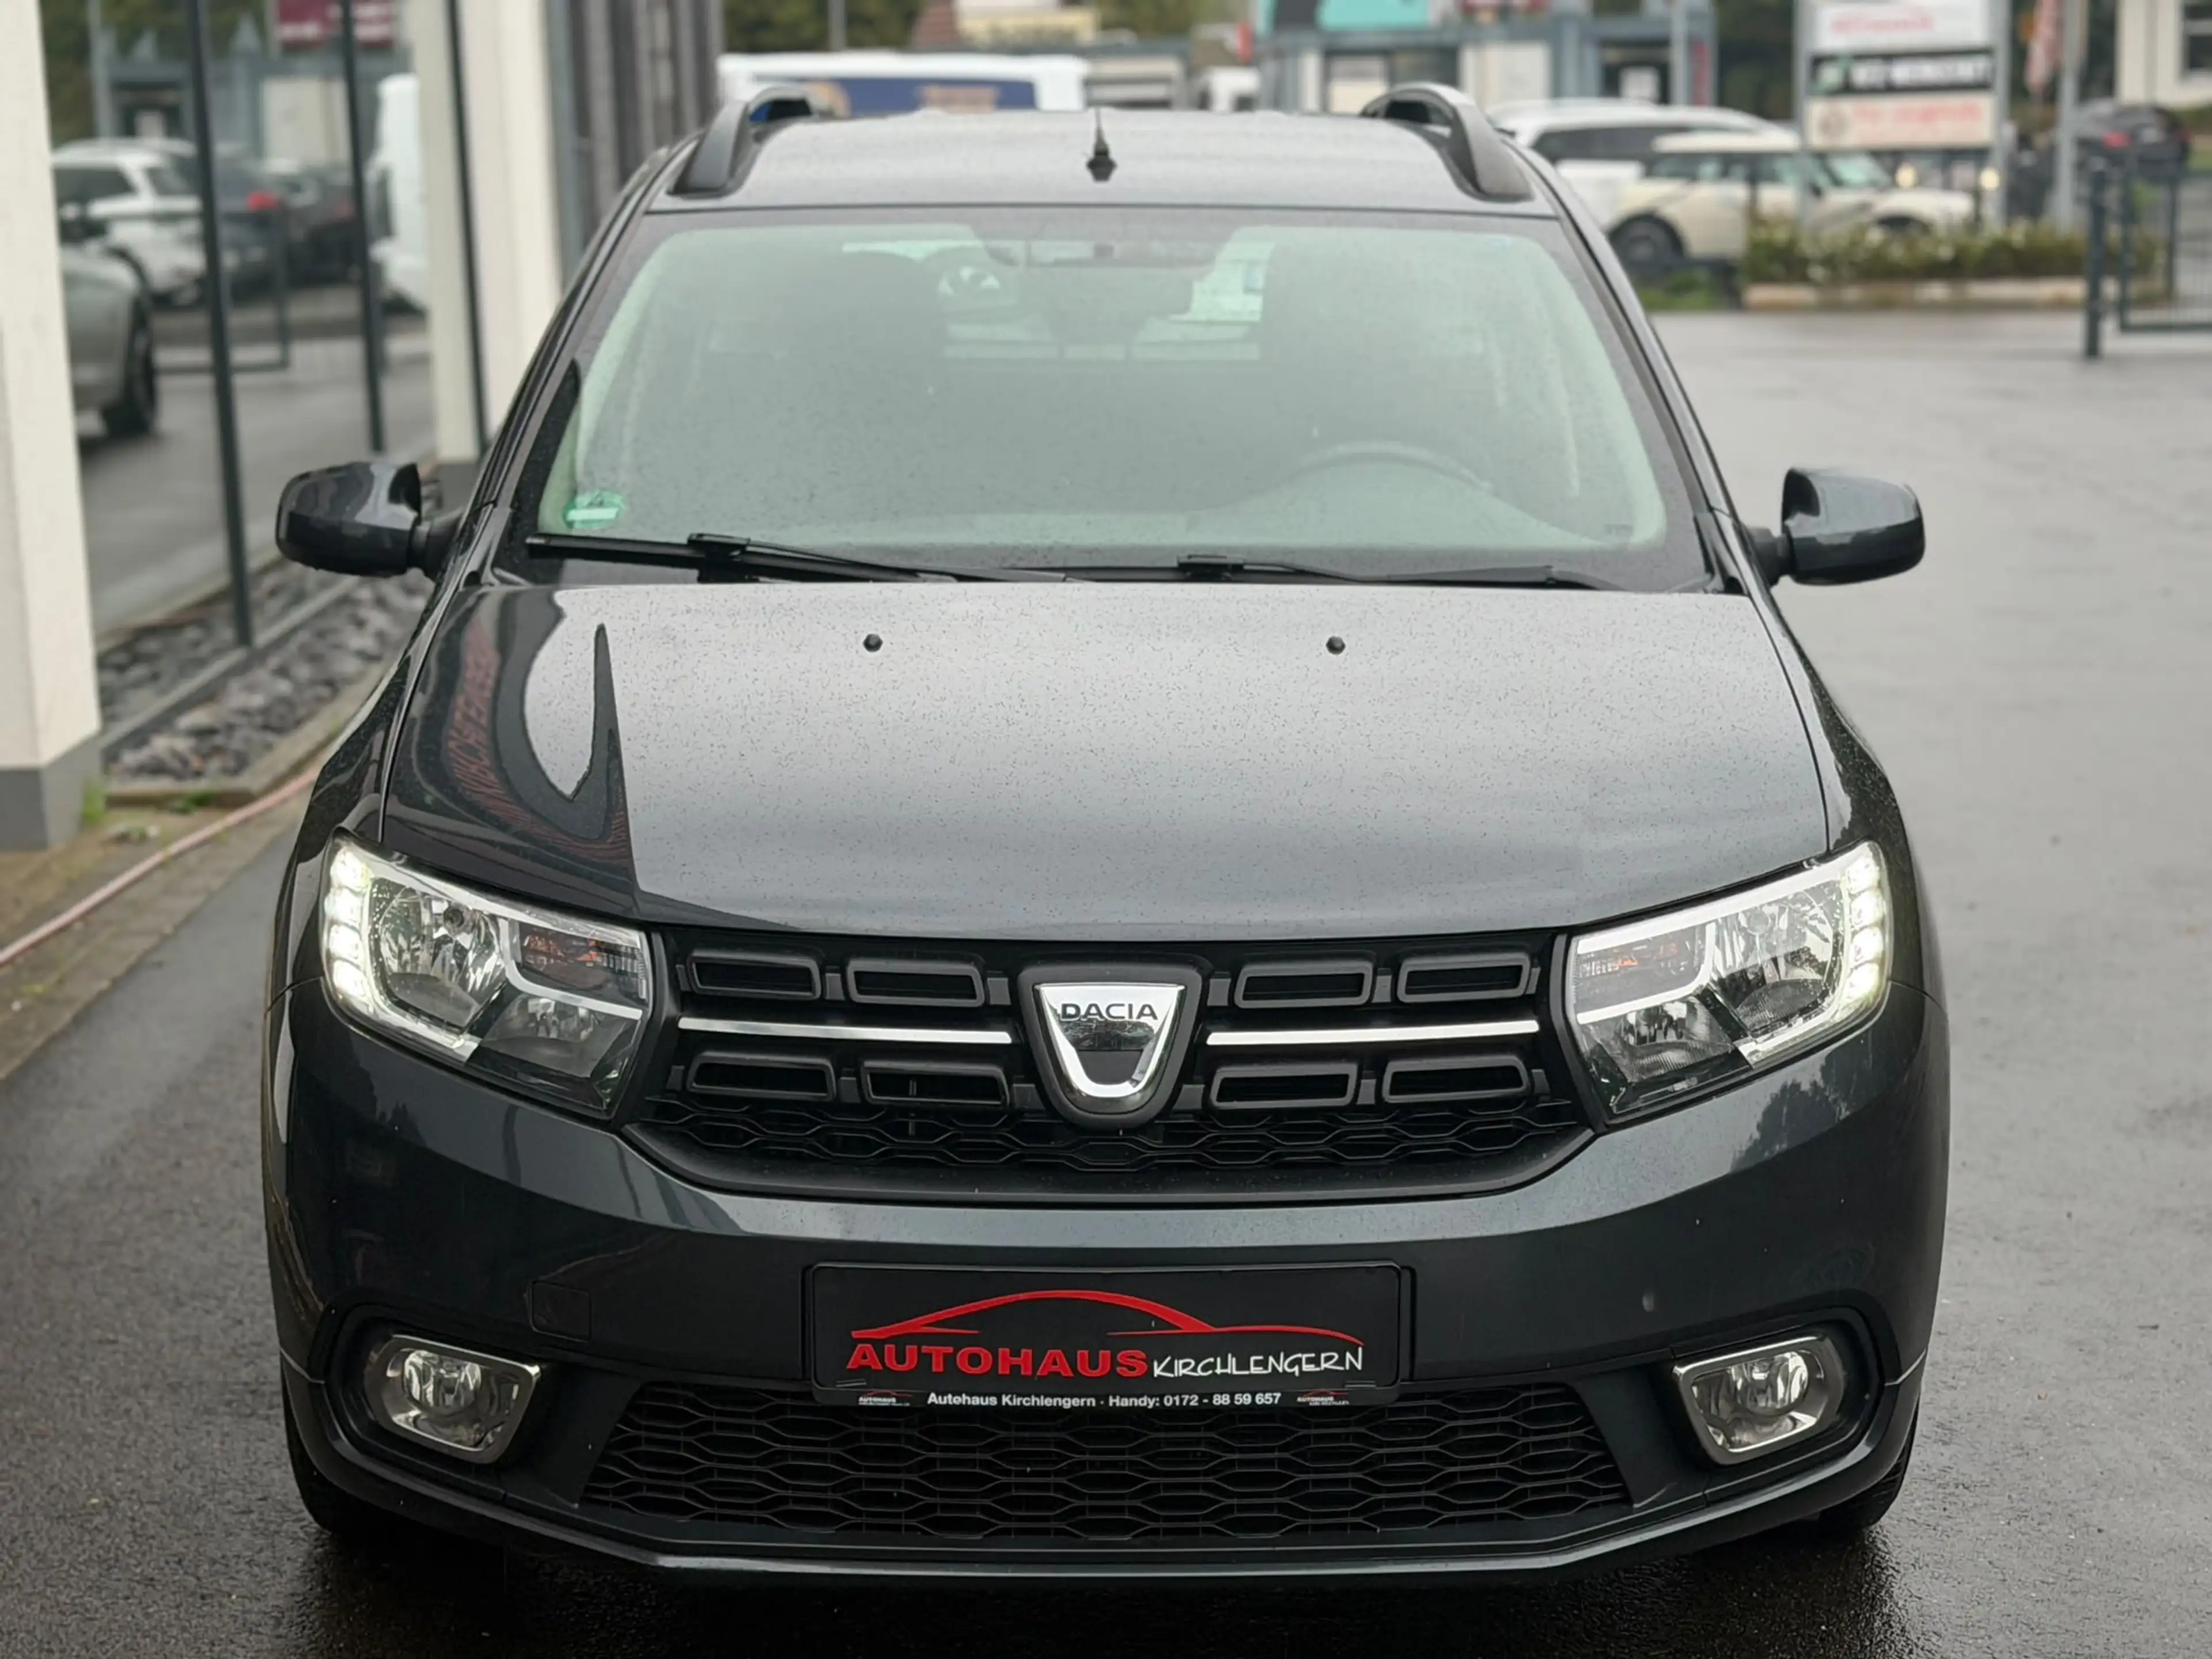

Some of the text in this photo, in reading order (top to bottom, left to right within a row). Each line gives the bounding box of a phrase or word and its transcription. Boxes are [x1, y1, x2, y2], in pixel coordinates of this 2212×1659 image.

[1061, 1003, 1158, 1020] DACIA
[847, 1343, 1363, 1378] AUTOHAUS KIRCHLENGERN
[927, 1392, 998, 1406] Autohaus
[1002, 1393, 1096, 1409] Kirchlengern
[1108, 1395, 1160, 1409] Handy:
[1163, 1393, 1199, 1407] 0172
[1212, 1393, 1231, 1406] 88
[1234, 1392, 1252, 1406] 59
[1255, 1392, 1282, 1405] 657
